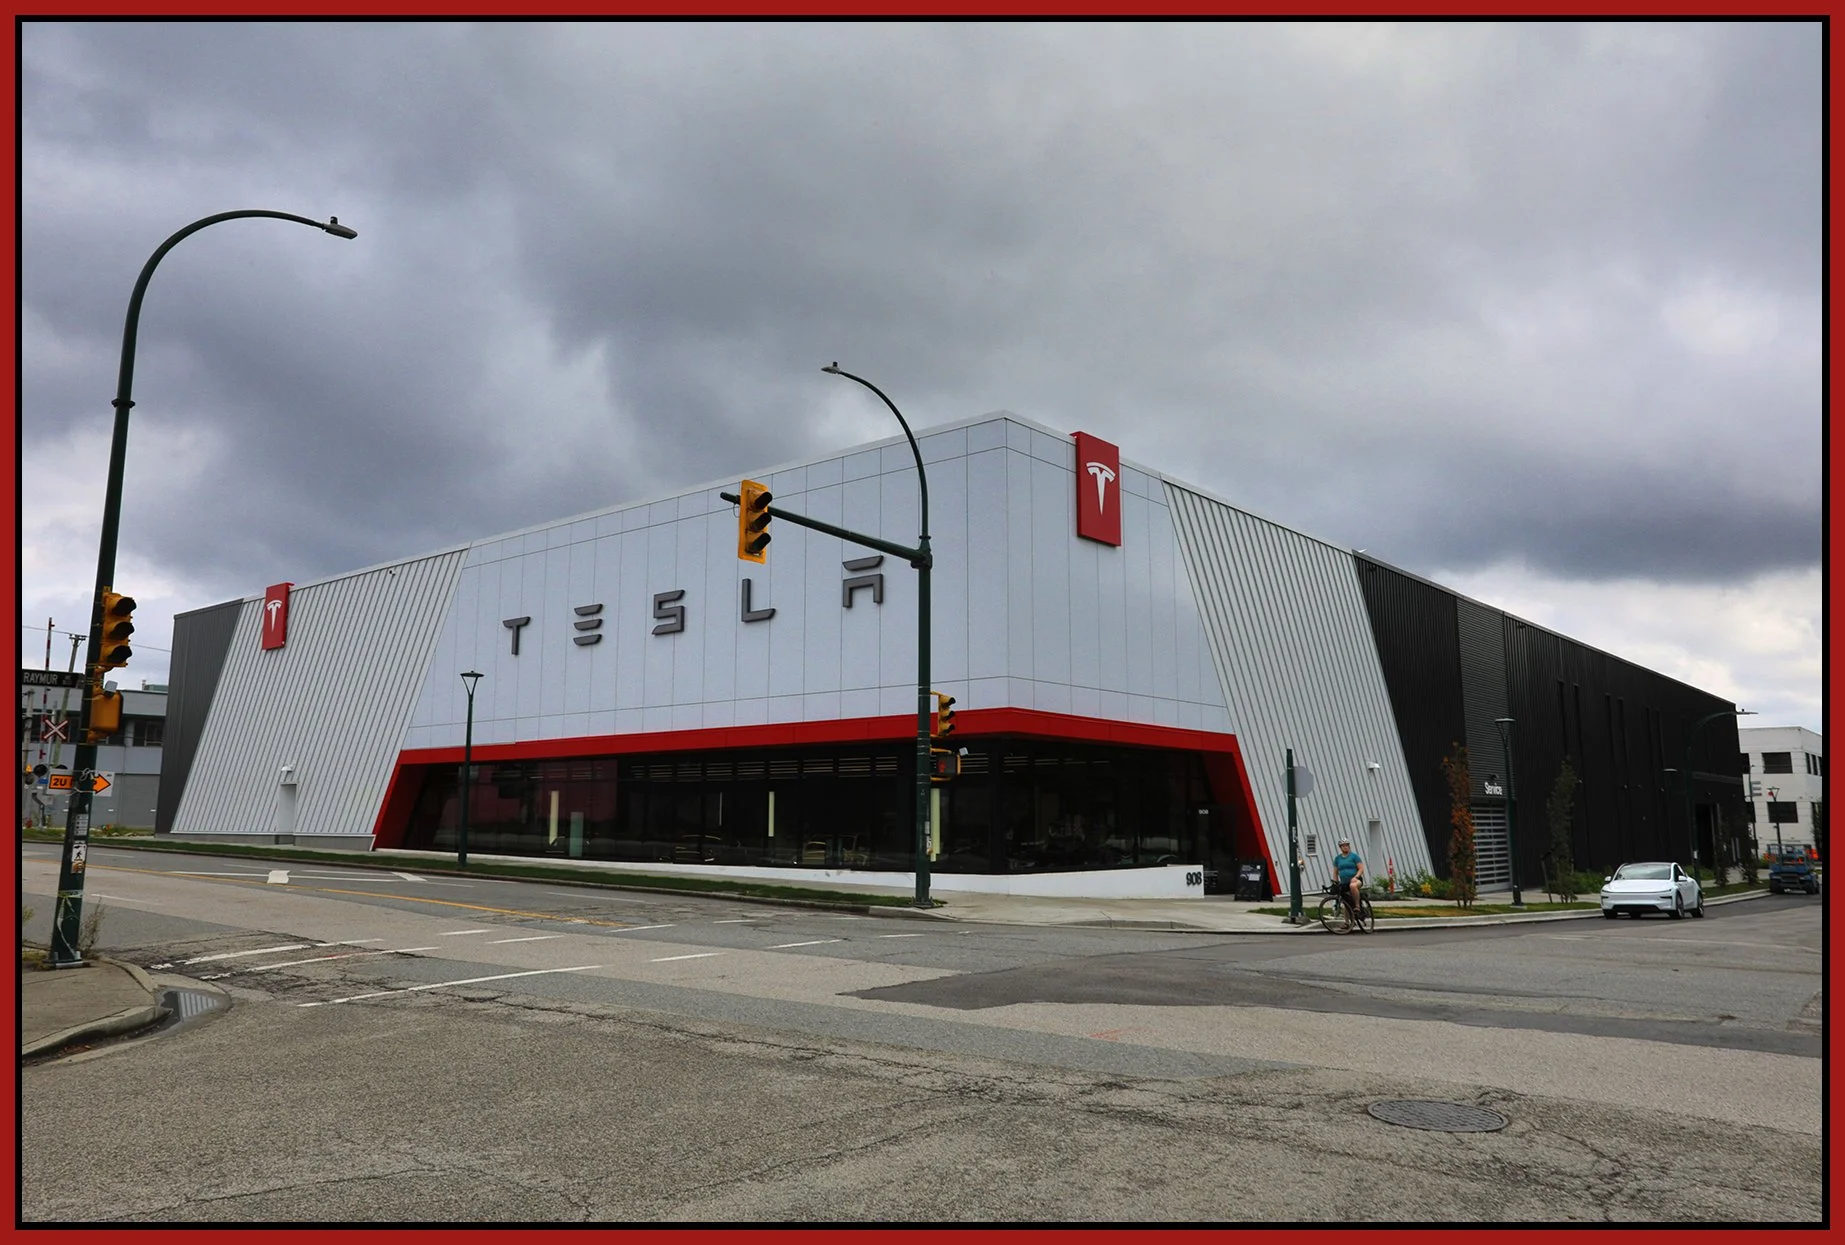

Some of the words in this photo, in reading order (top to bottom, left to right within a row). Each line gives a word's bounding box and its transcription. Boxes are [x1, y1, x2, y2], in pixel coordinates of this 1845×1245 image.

[502, 554, 885, 656] TESLA
[23, 672, 58, 685] RAYMUR
[1484, 781, 1503, 795] Service
[1186, 872, 1202, 886] 908
